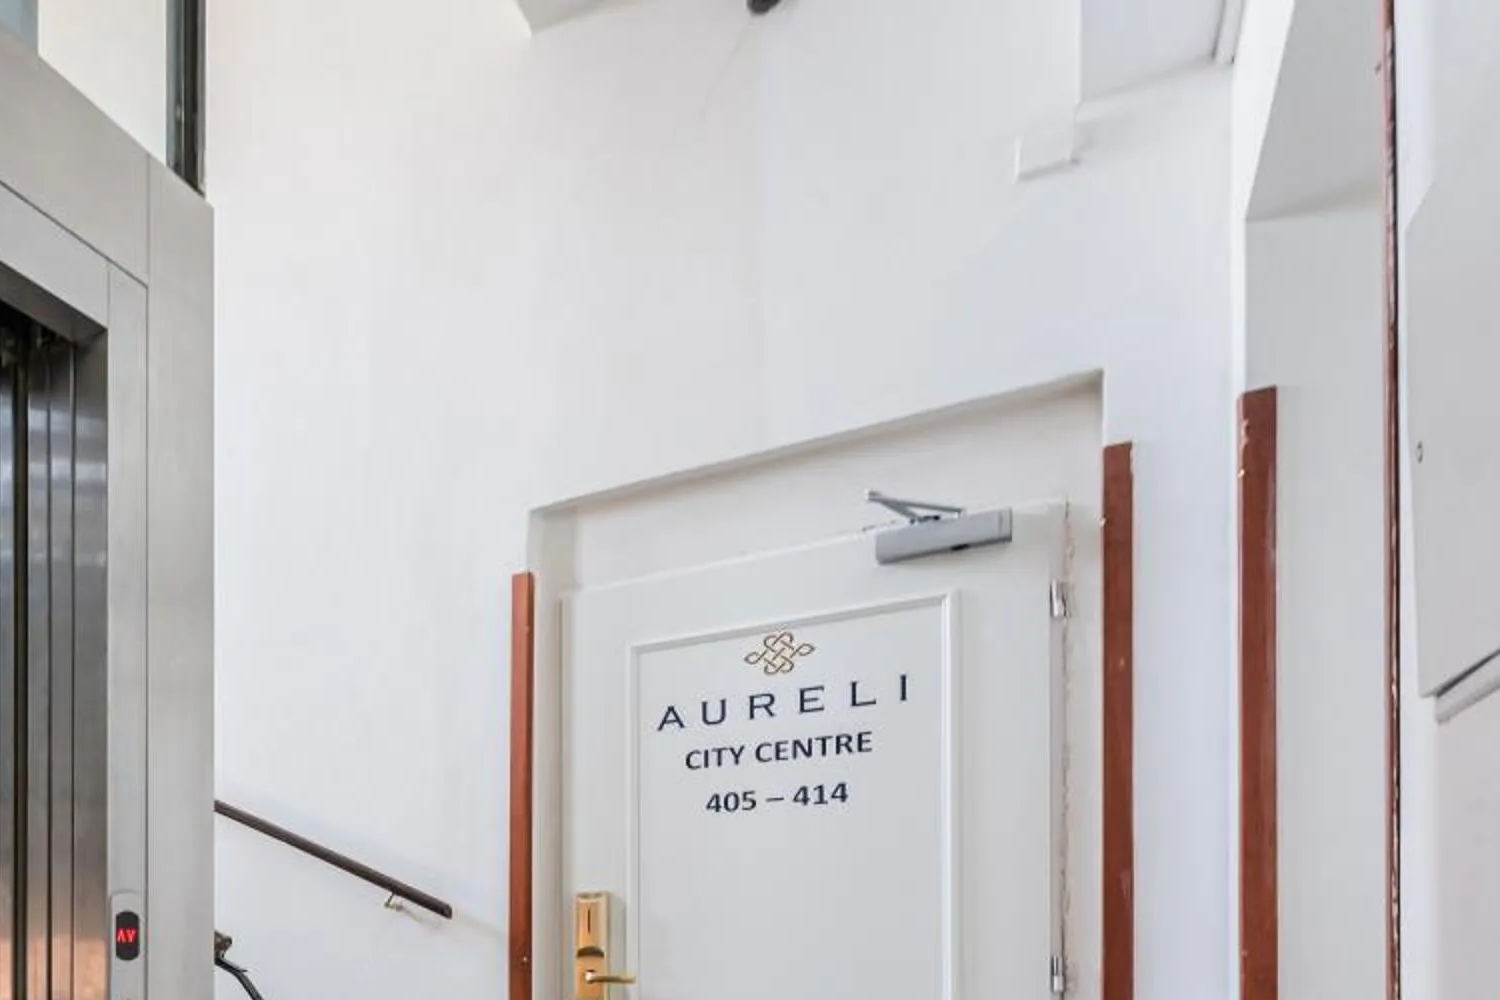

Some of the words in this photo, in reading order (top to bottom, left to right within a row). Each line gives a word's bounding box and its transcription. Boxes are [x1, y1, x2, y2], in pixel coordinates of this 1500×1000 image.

[656, 673, 909, 732] AURELI
[685, 745, 745, 770] CITY
[754, 731, 873, 763] CENTRE
[705, 790, 757, 813] 405
[792, 782, 849, 806] 414
